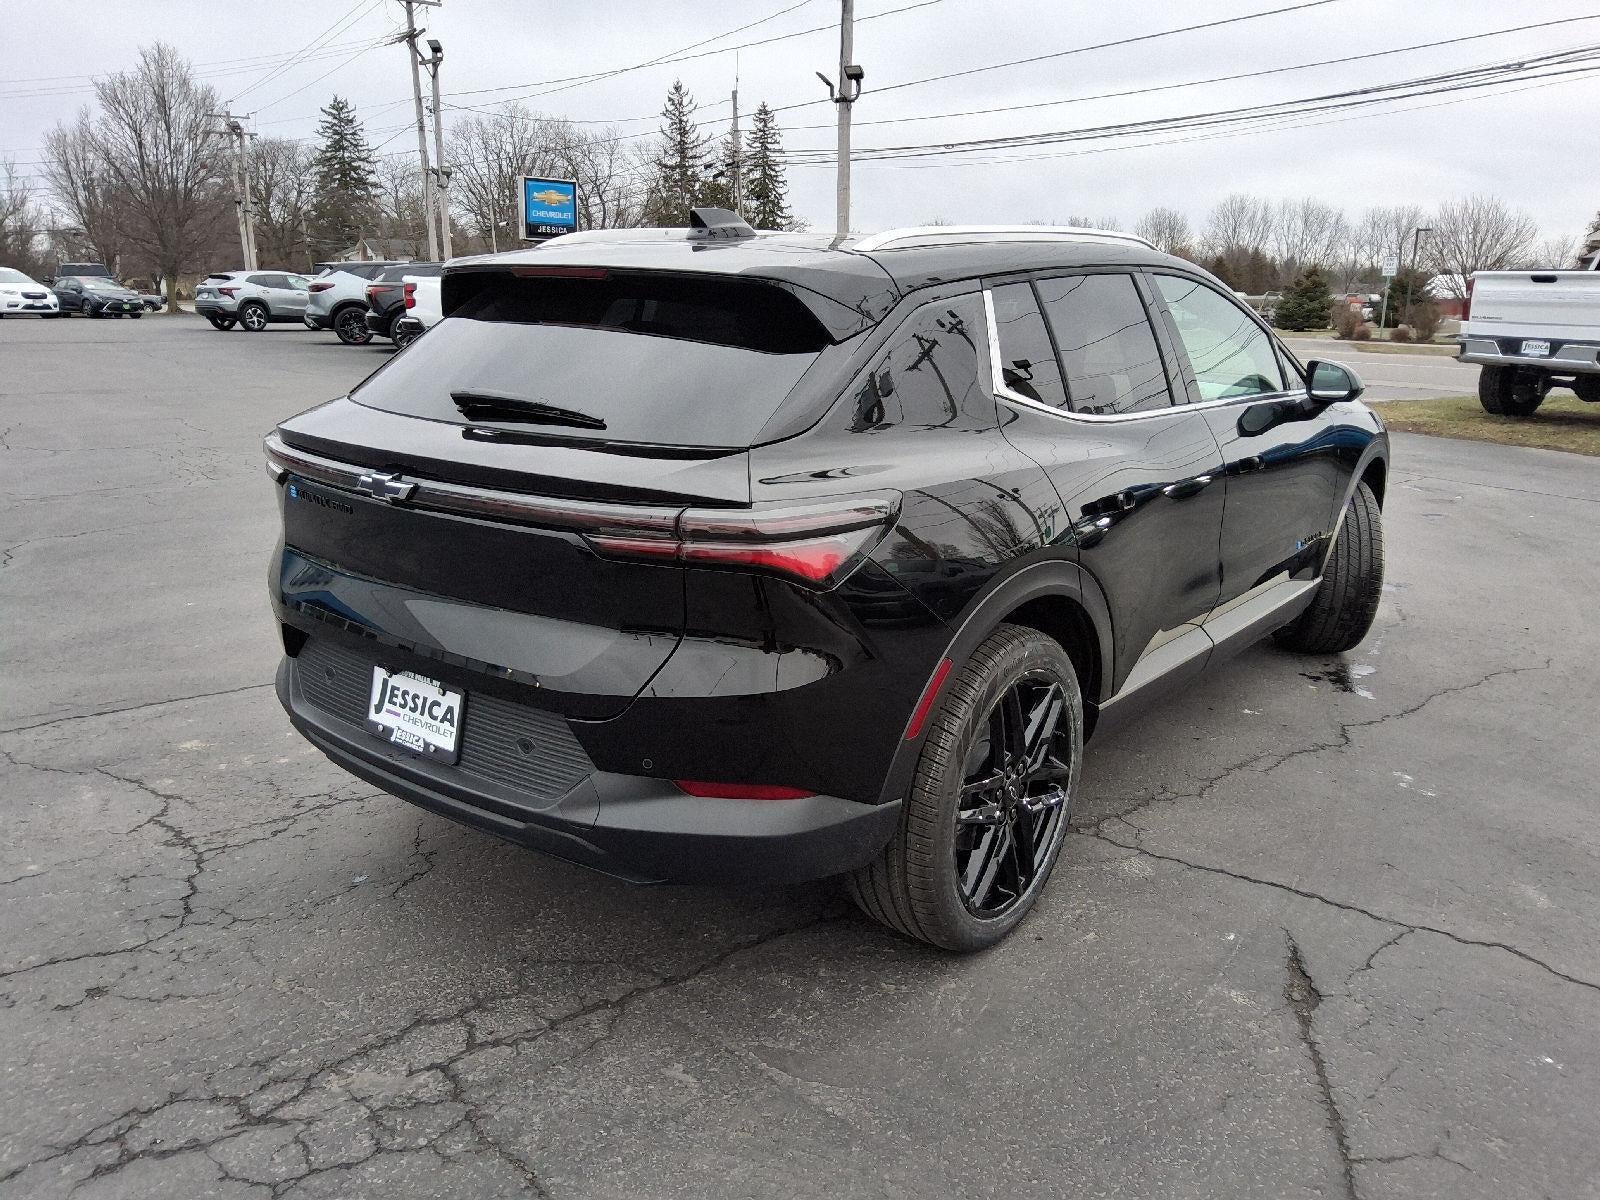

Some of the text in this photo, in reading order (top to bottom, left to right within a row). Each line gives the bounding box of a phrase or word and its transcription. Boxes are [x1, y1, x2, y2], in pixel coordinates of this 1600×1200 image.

[532, 210, 571, 219] CHEVROLET
[537, 225, 568, 234] JESSICA
[1523, 342, 1549, 352] JESSICA
[374, 677, 455, 728] JESSICA
[402, 713, 454, 739] CHEVROLET
